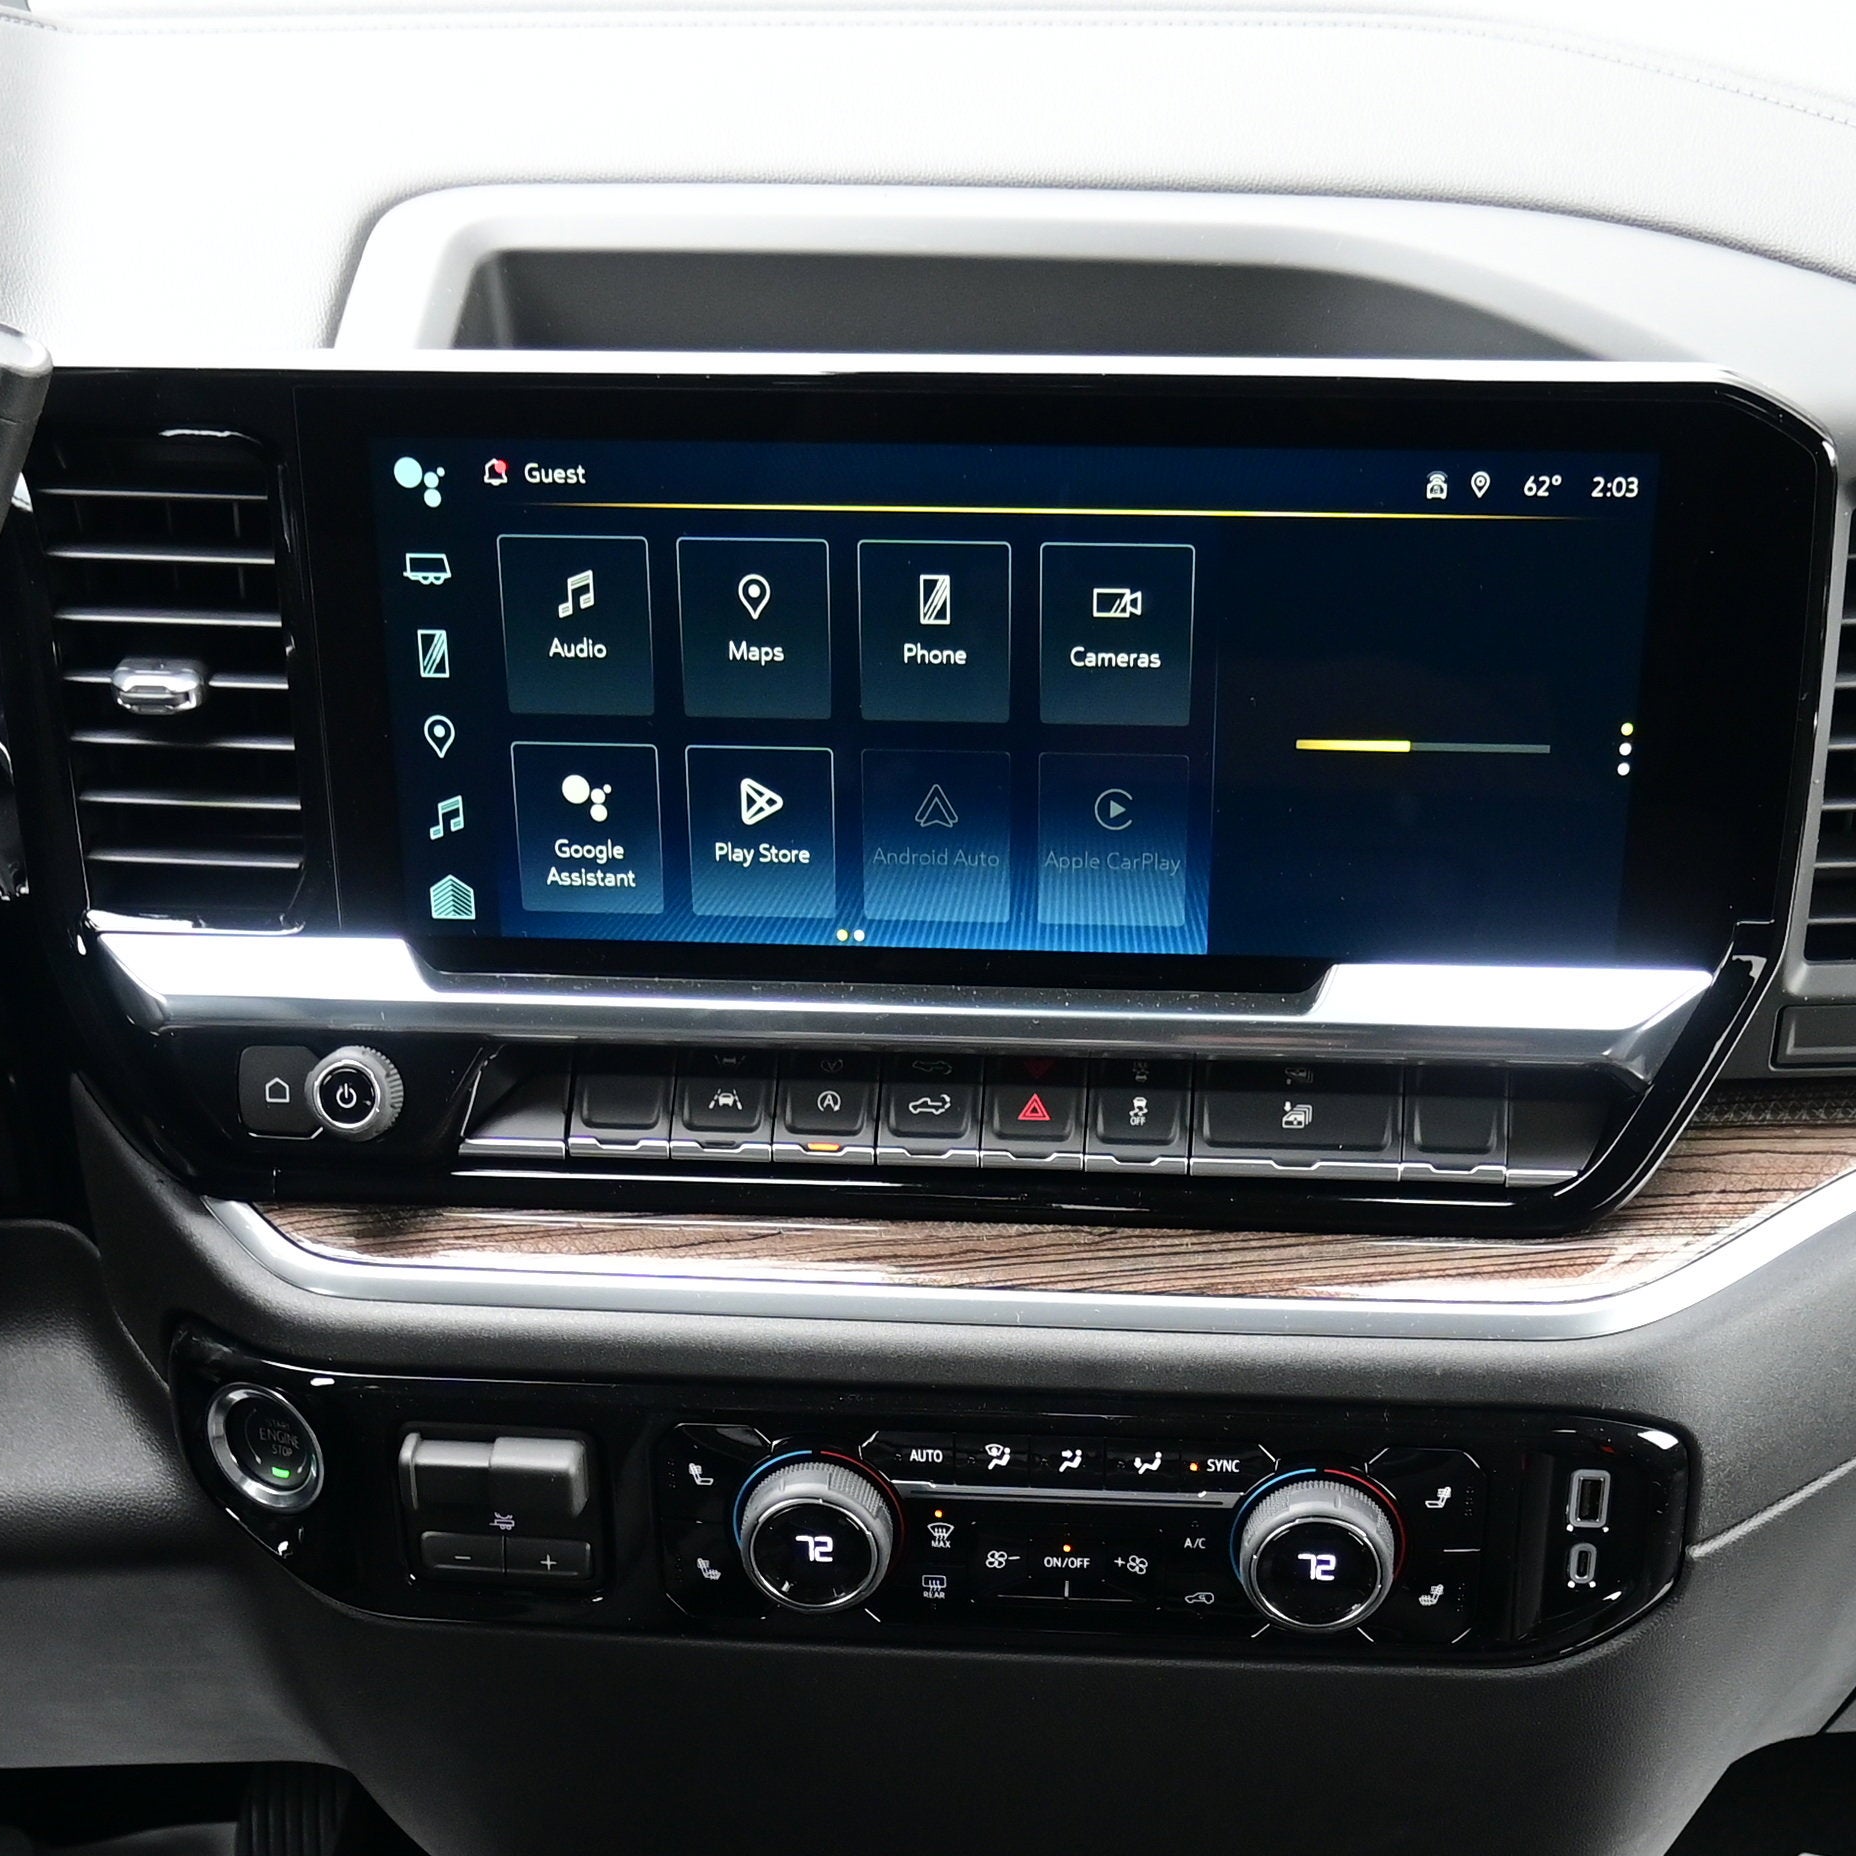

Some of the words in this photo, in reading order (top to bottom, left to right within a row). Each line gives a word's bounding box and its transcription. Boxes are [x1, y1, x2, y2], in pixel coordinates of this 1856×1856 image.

[524, 462, 586, 485] Guest
[1590, 475, 1639, 499] 2:03
[549, 637, 608, 660] Audio
[728, 640, 785, 665] Maps
[902, 642, 968, 666] Phone
[1069, 645, 1162, 669] Cameras
[553, 838, 625, 862] Google
[714, 840, 753, 868] Play
[757, 842, 812, 866] Store
[872, 846, 950, 867] Android
[952, 847, 1001, 869] Auto
[1044, 850, 1102, 874] Apple
[1106, 851, 1182, 877] CarPlay
[546, 867, 637, 890] Assistant
[259, 1427, 300, 1450] ENGINE
[271, 1444, 293, 1457] STOP
[909, 1449, 943, 1463] AUTO
[1206, 1458, 1241, 1474] SYNC
[796, 1535, 834, 1563] 72
[931, 1540, 951, 1549] MAX
[1184, 1536, 1207, 1551] A/C
[1043, 1554, 1091, 1570] ON/OFF
[1298, 1553, 1337, 1582] 72
[923, 1590, 945, 1599] REAR
